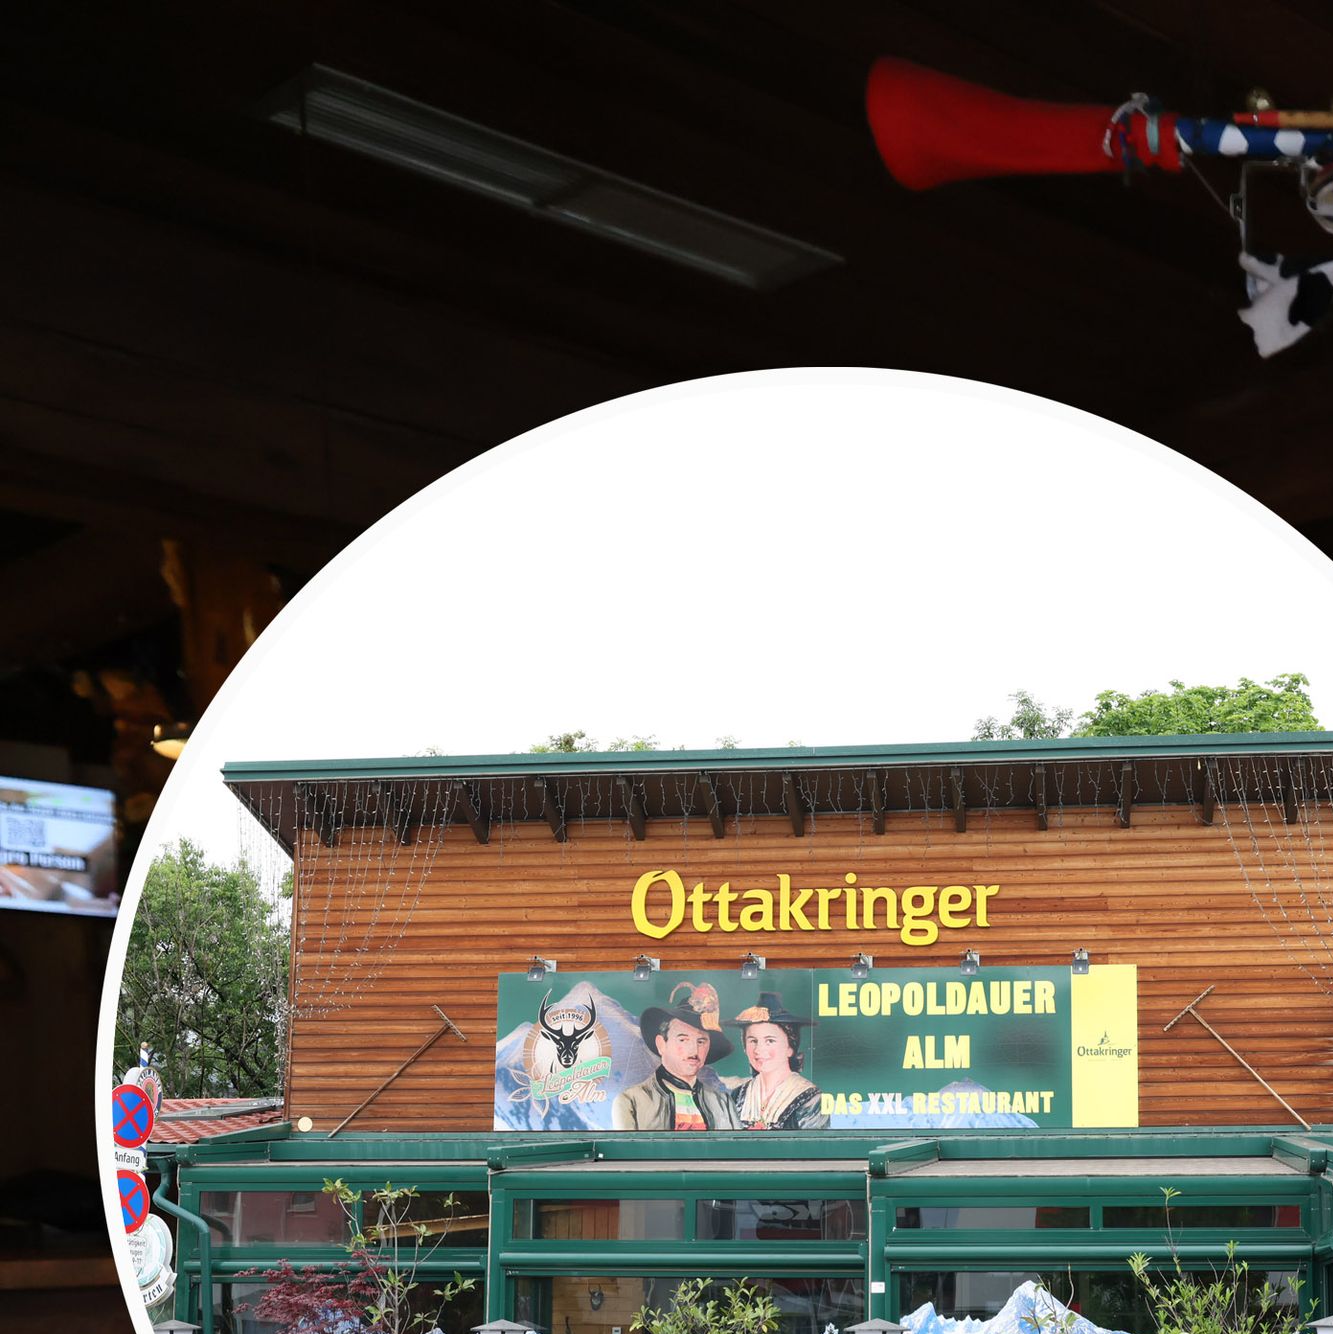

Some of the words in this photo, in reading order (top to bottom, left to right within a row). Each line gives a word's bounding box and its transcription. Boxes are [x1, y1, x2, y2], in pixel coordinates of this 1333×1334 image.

[631, 869, 1000, 945] Ottakringer
[818, 980, 1056, 1017] LEOPOLDAUER
[902, 1035, 971, 1069] ALM
[1077, 1046, 1132, 1058] Ottakringer
[542, 1060, 608, 1094] Leopoldauer
[561, 1080, 606, 1102] Alm
[821, 1093, 863, 1115] DAS
[867, 1092, 908, 1115] XXL
[912, 1091, 1055, 1114] RESTAURANT
[114, 1152, 140, 1167] Anfang
[143, 1283, 163, 1303] rten
